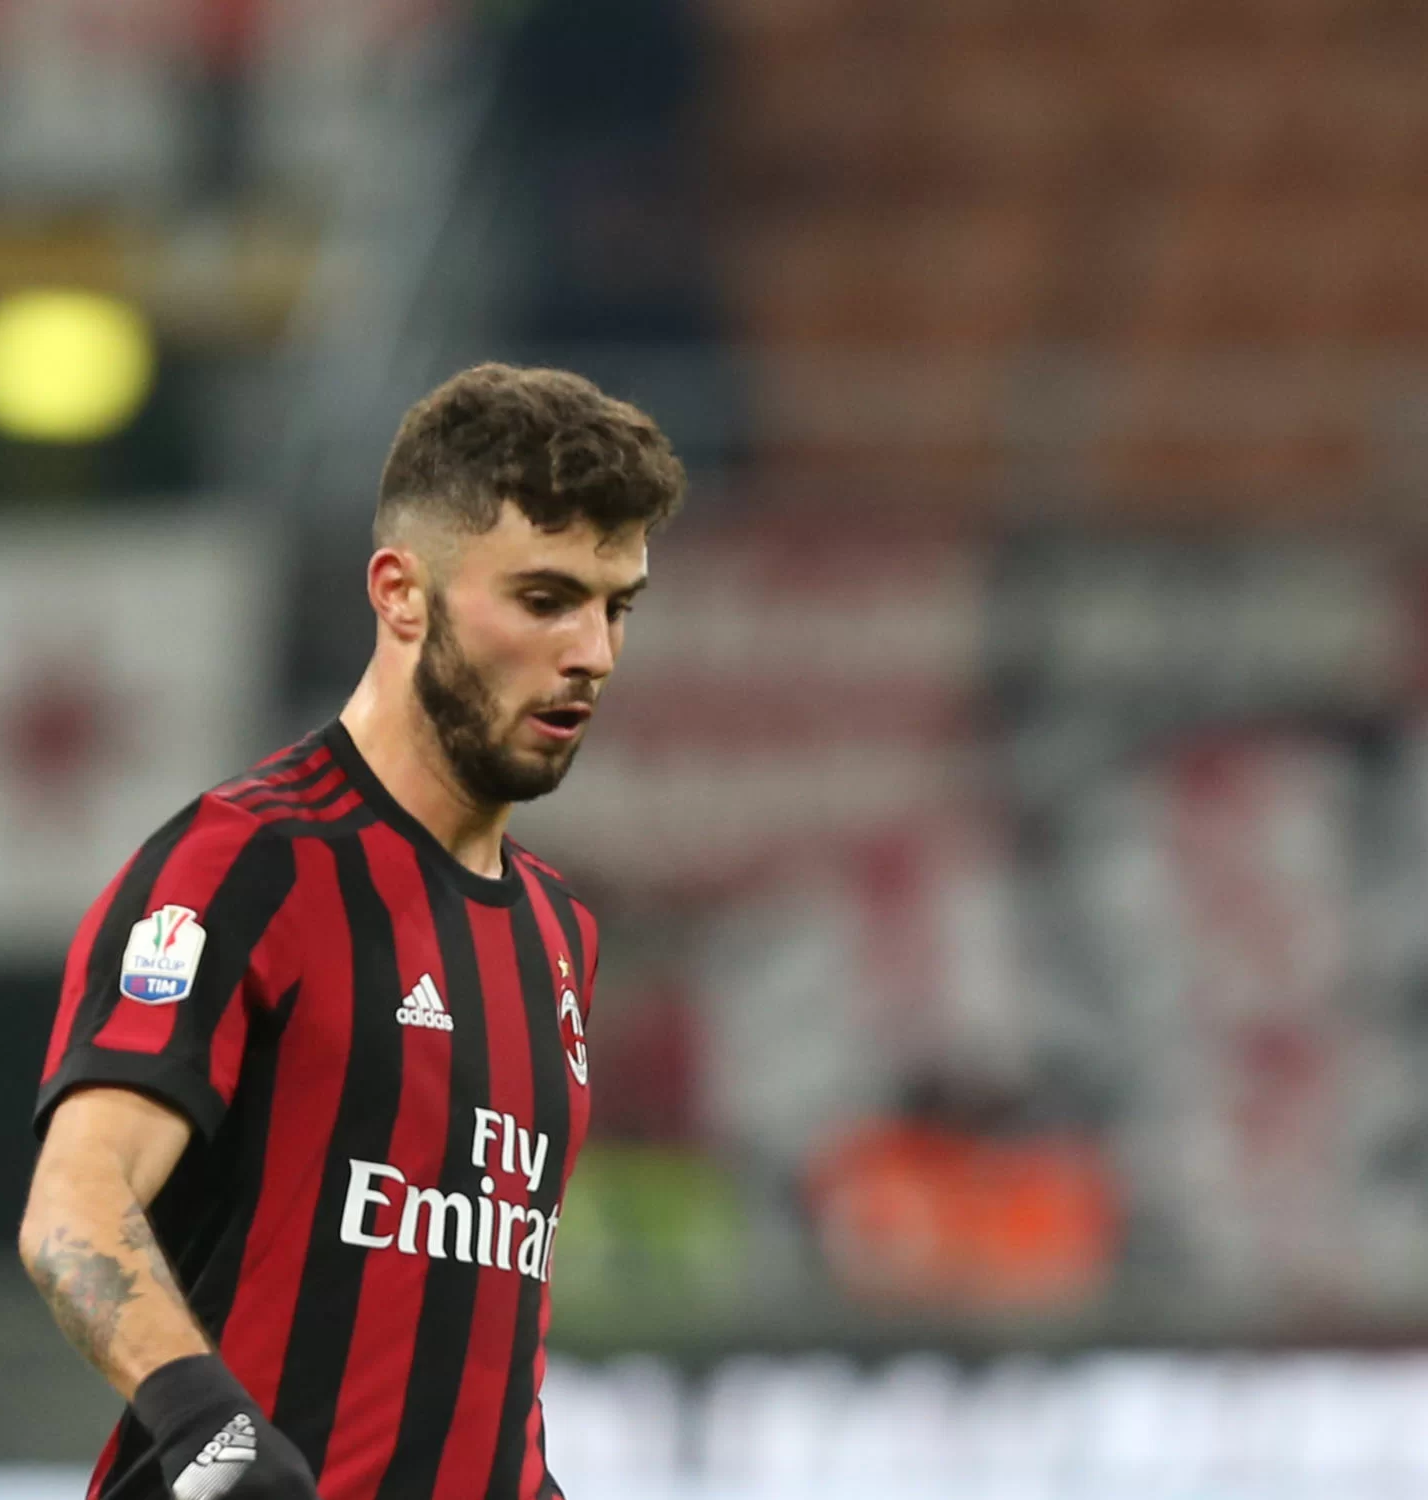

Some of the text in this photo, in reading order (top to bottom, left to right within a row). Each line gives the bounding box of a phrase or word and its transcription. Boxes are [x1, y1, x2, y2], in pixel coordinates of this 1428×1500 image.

[147, 978, 178, 995] TIM
[396, 1007, 454, 1032] adidas
[472, 1107, 549, 1192] Fly
